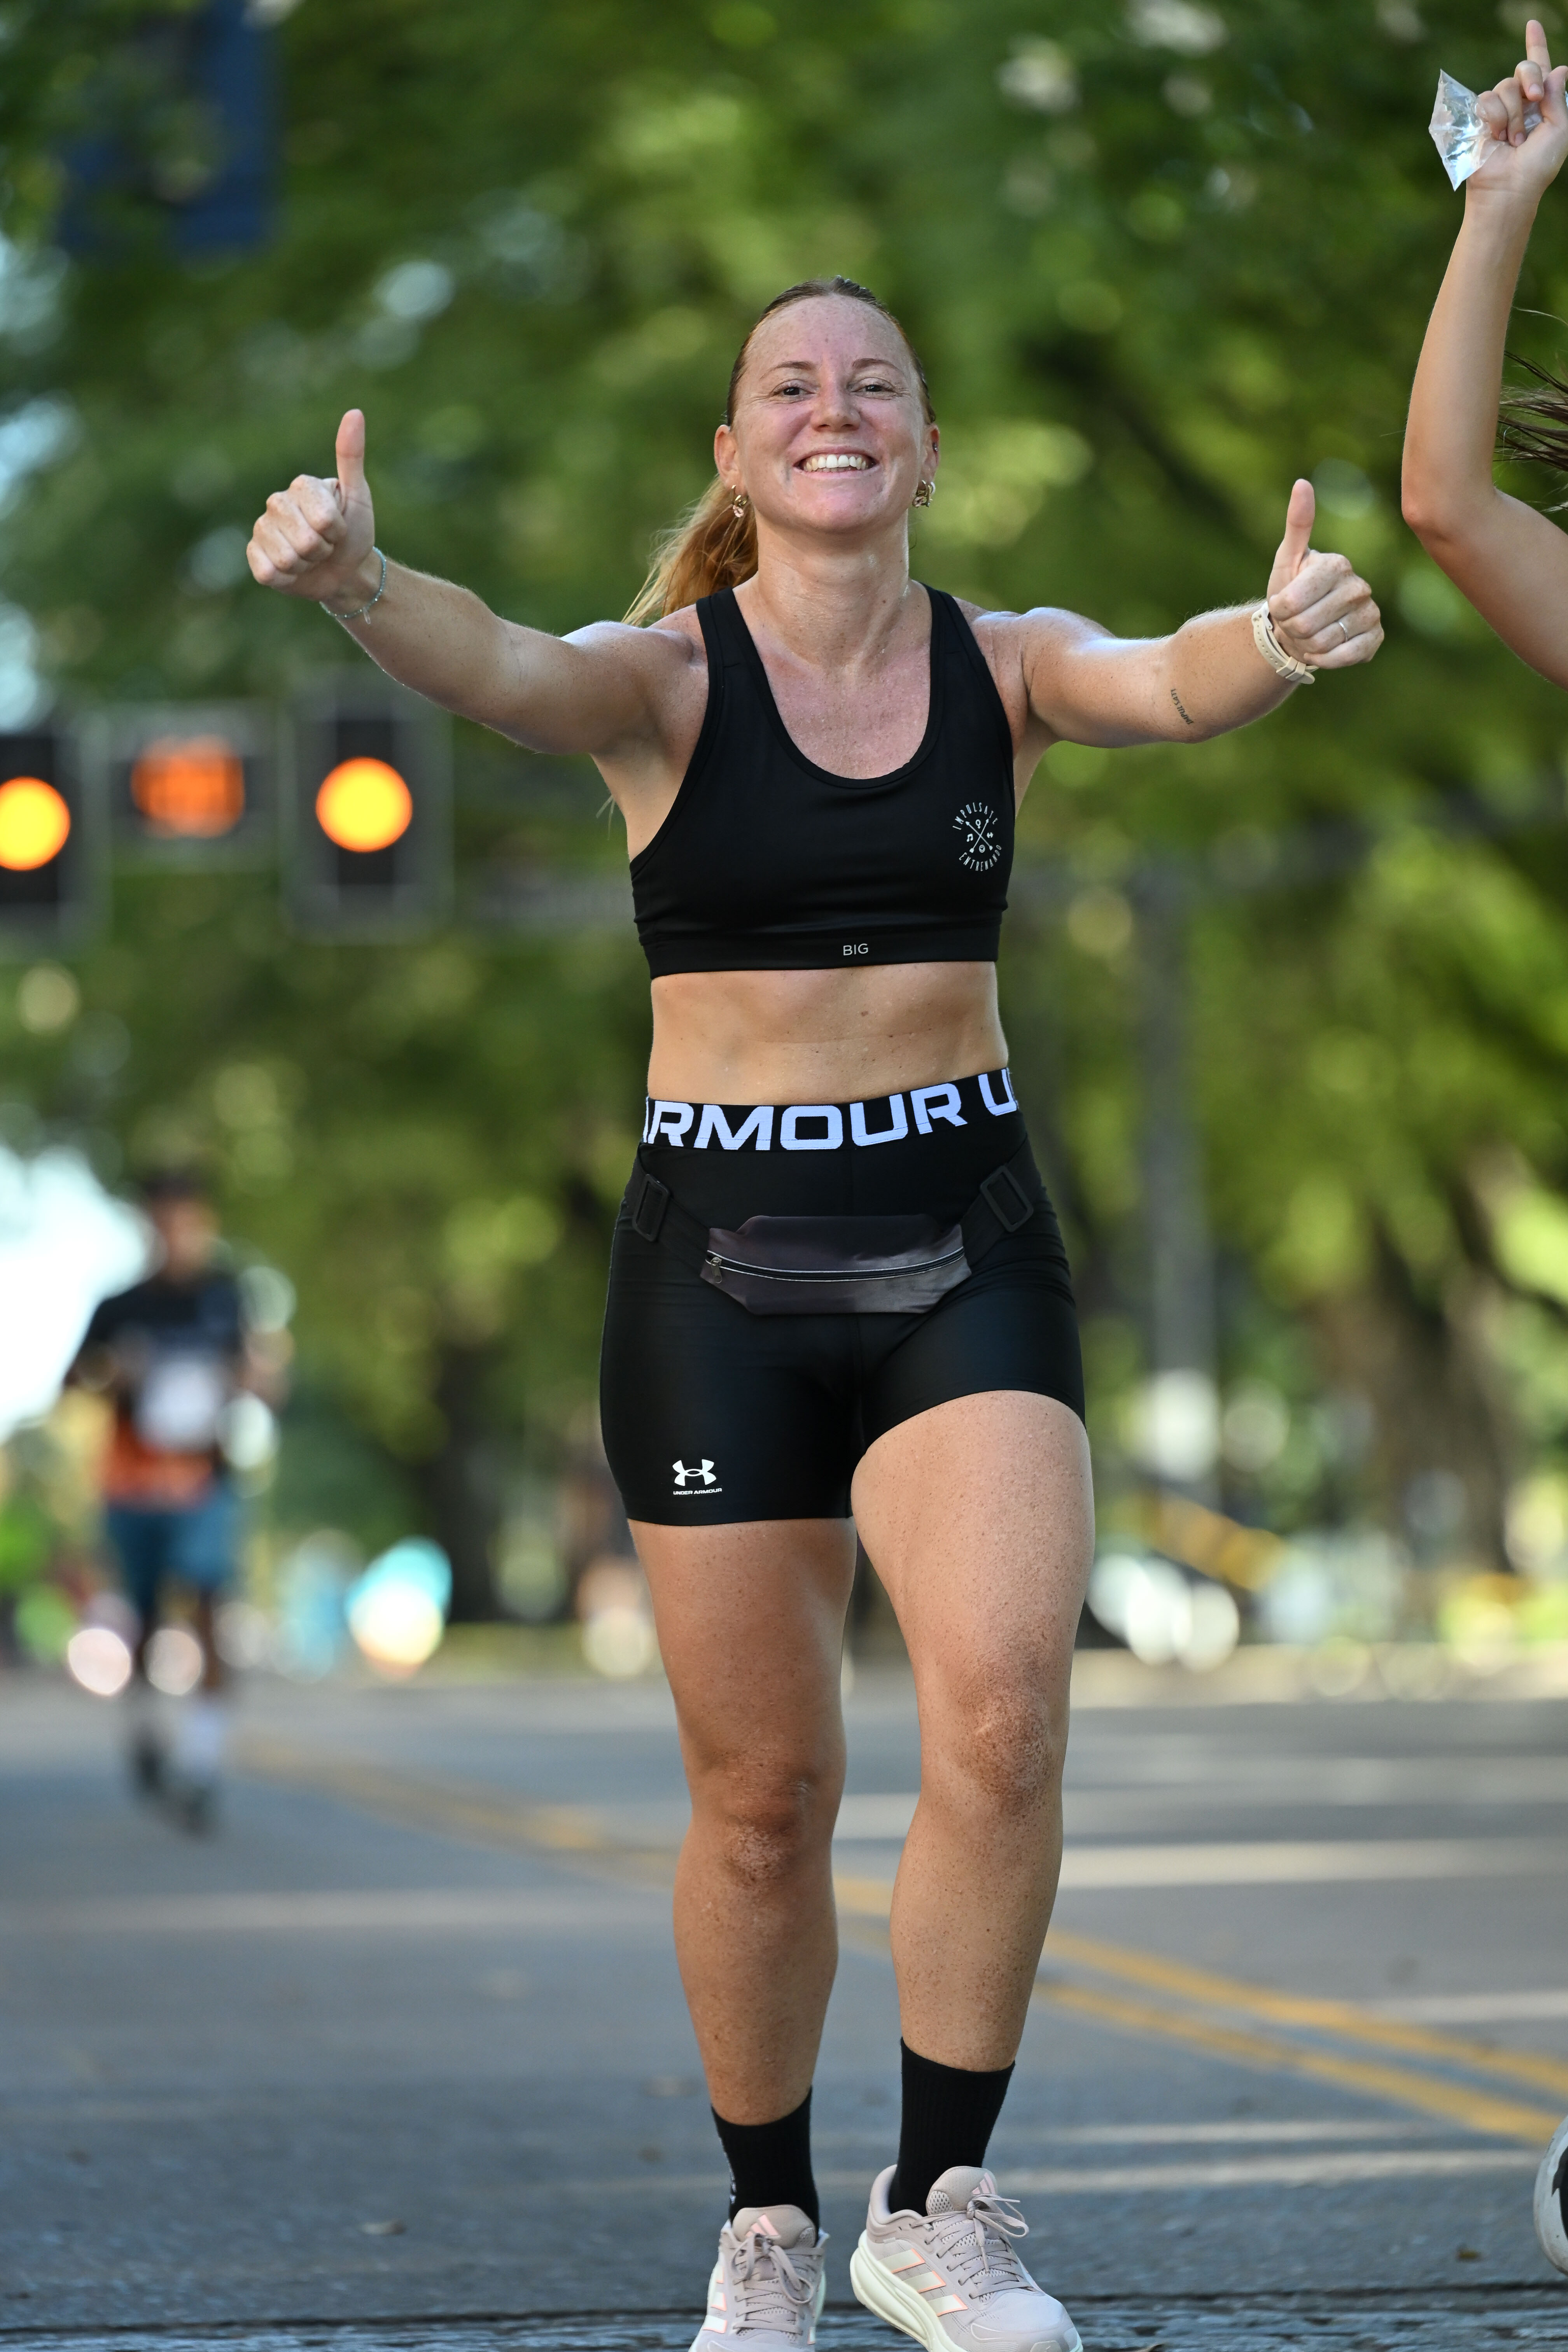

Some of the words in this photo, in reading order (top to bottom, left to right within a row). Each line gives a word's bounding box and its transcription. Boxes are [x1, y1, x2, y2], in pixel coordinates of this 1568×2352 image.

[952, 802, 998, 830] IMPULSATE
[959, 845, 1002, 871] ENTRENANDO
[843, 943, 868, 956] BIG
[643, 1083, 968, 1150] RMOUR
[978, 1068, 1019, 1116] U
